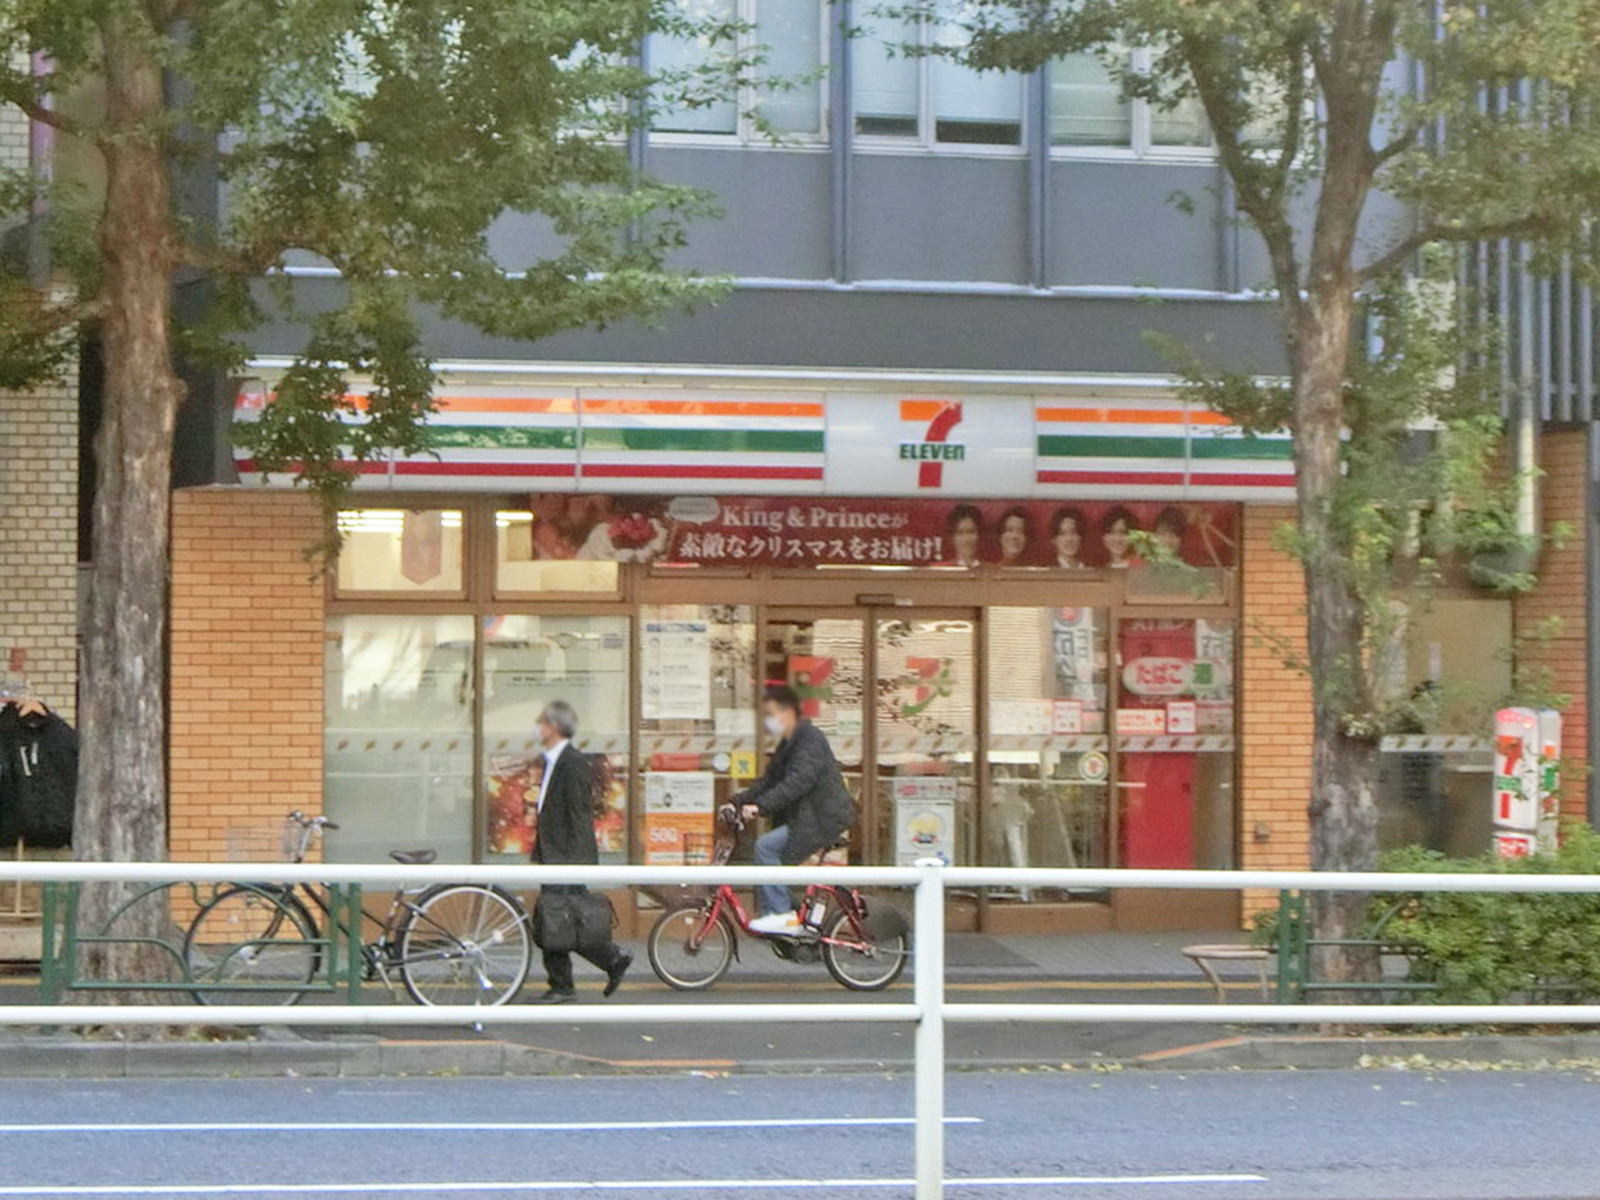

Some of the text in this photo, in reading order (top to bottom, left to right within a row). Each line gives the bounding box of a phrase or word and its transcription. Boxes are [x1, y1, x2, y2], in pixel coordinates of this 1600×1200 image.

[899, 400, 963, 488] 7
[722, 506, 784, 533] King
[787, 506, 805, 528] &
